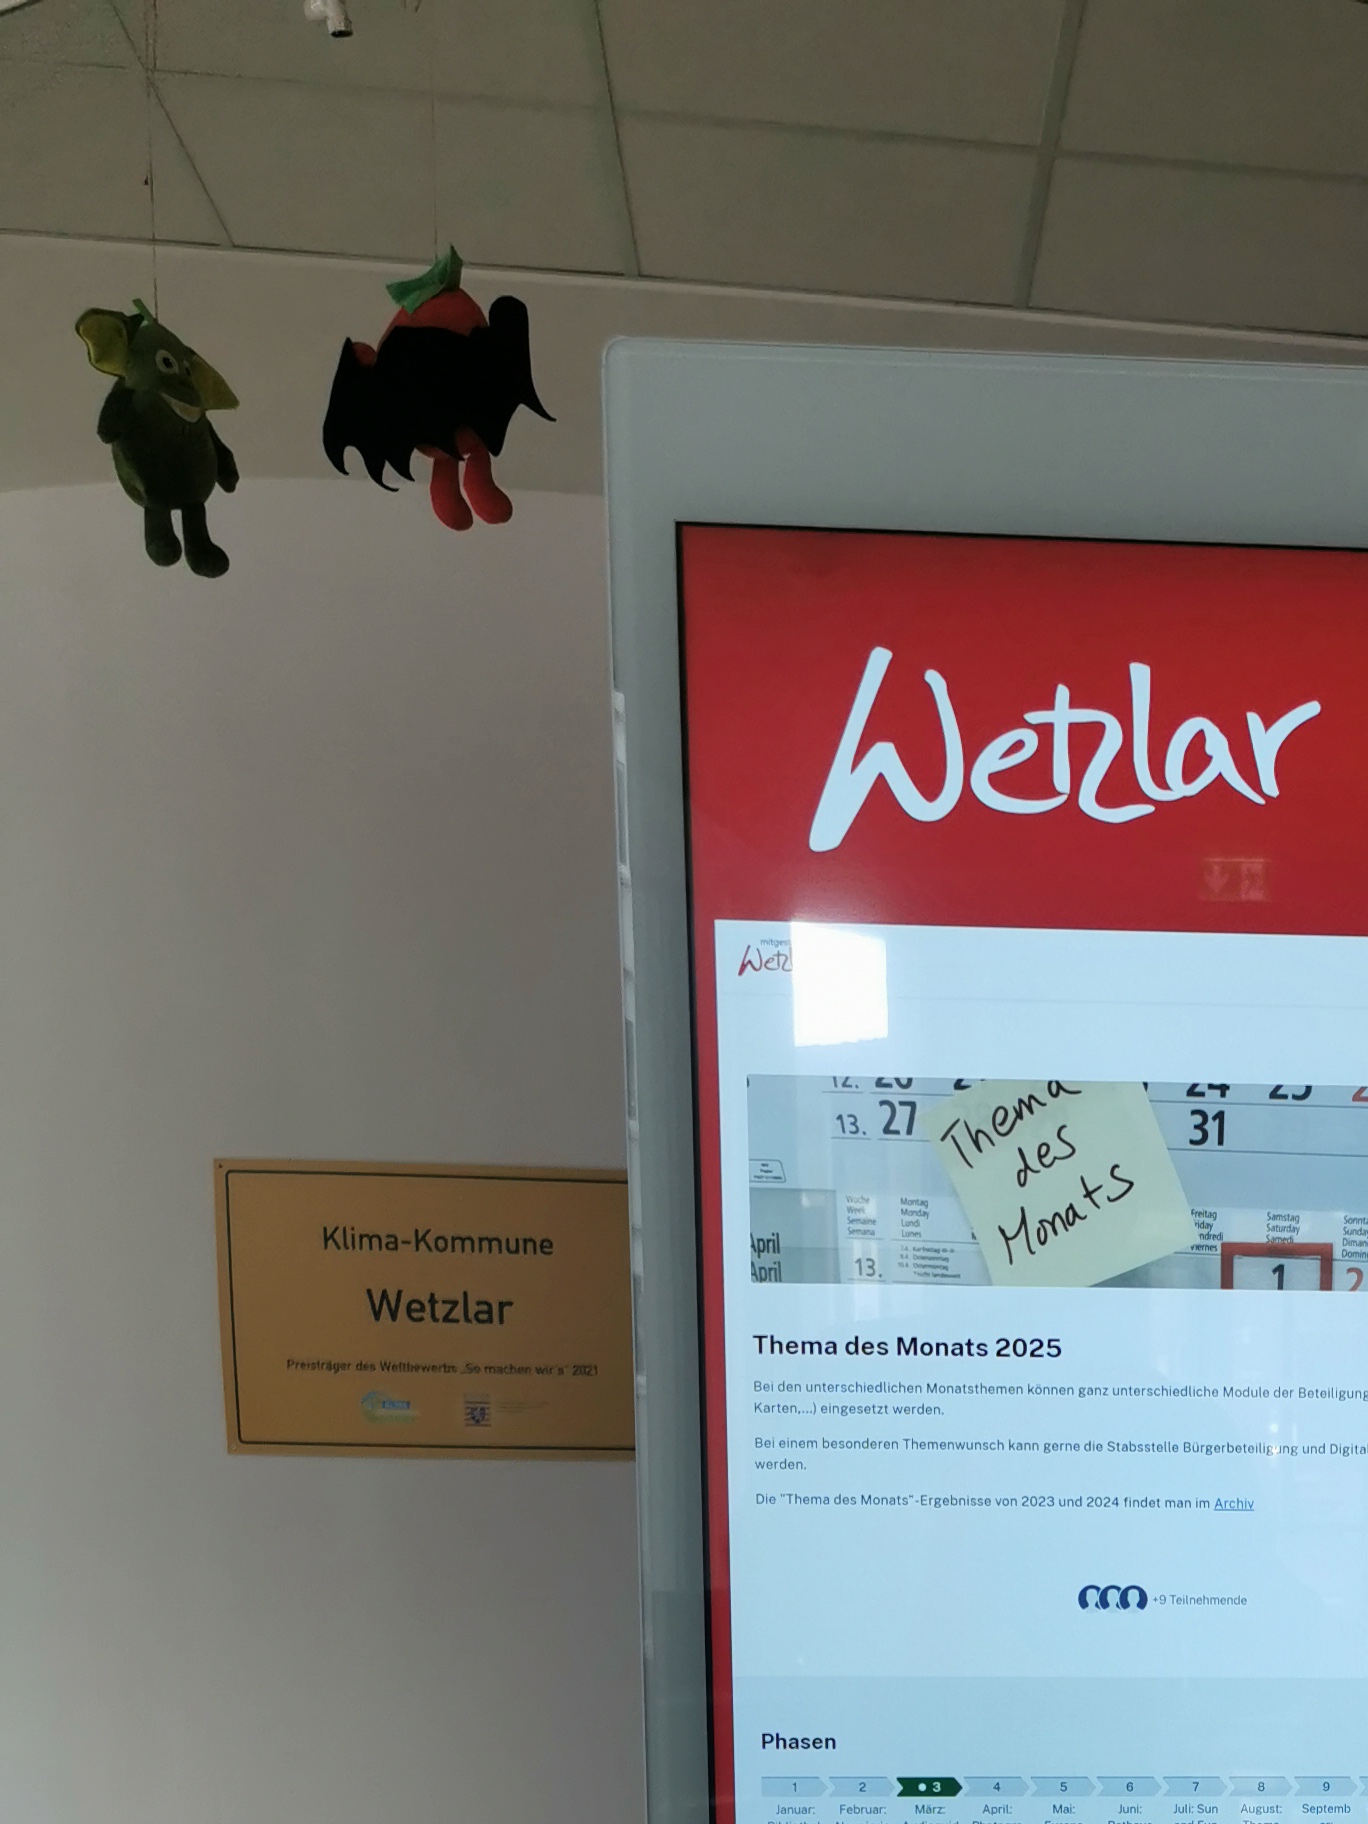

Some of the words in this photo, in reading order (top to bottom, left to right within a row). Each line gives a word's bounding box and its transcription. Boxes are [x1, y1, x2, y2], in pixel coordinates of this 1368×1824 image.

[809, 646, 1321, 852] Wetzlar
[835, 1113, 867, 1136] 13.
[878, 1099, 917, 1136] 27
[940, 1080, 1082, 1168] Thema
[1189, 1109, 1226, 1147] 31
[1016, 1124, 1076, 1187] des
[998, 1163, 1135, 1265] Monats
[1266, 1211, 1300, 1224] Samstag
[1266, 1223, 1300, 1234] Saturday
[322, 1225, 555, 1257] Klima-Kommune
[366, 1287, 515, 1326] Wetzlar
[752, 1334, 838, 1356] Thema
[844, 1335, 889, 1357] des
[896, 1336, 989, 1358] Monats
[995, 1337, 1062, 1359] 2025
[356, 1359, 377, 1373] des
[484, 1364, 532, 1376] machen
[753, 1380, 774, 1393] Bei
[777, 1380, 802, 1393] den
[805, 1380, 923, 1394] unterschiedlichen
[926, 1381, 1024, 1396] Monatsthemen
[1027, 1383, 1075, 1396] können
[1078, 1386, 1109, 1399] ganz
[1112, 1384, 1219, 1398] unterschiedliche
[1222, 1385, 1270, 1399] Module
[1273, 1385, 1295, 1399] der
[755, 1492, 777, 1505] Die
[779, 1492, 830, 1506] "Thema
[833, 1493, 857, 1506] des
[860, 1493, 992, 1509] Monats"-Ergebnisse
[994, 1497, 1018, 1507] von
[1021, 1495, 1055, 1508] 2023
[1058, 1495, 1083, 1508] und
[1086, 1495, 1120, 1509] 2024
[1123, 1495, 1161, 1509] findet
[1164, 1499, 1192, 1509] man
[1195, 1497, 1210, 1509] im
[1213, 1497, 1255, 1512] Archiv
[1152, 1594, 1167, 1606] +9
[1168, 1594, 1248, 1606] Teilnehmende
[760, 1732, 838, 1751] Phasen
[775, 1804, 816, 1816] Januar:
[839, 1804, 887, 1816] Februar:
[914, 1803, 946, 1815] März:
[1052, 1804, 1076, 1815] Mai:
[1173, 1803, 1195, 1815] Juli:
[1197, 1803, 1219, 1814] Sun
[1240, 1803, 1283, 1816] August:
